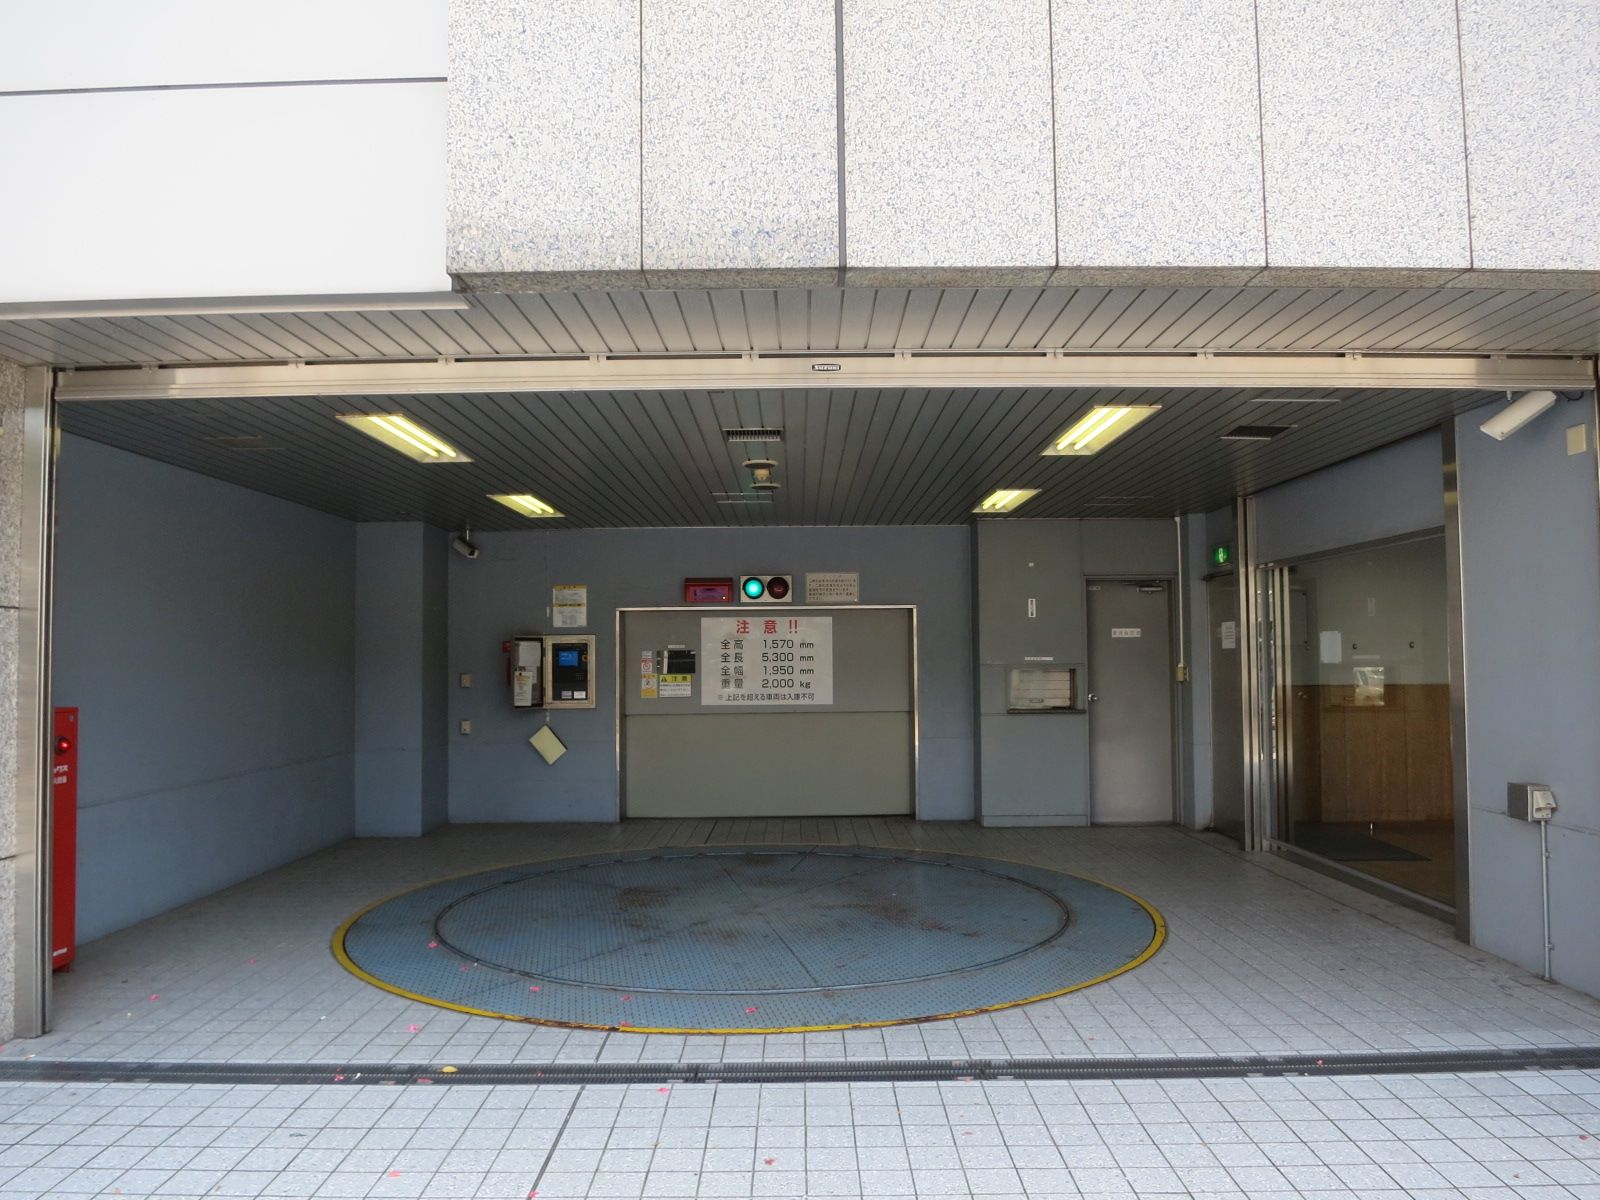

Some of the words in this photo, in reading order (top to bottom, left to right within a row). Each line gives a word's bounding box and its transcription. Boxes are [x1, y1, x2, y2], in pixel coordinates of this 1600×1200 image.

[720, 639, 744, 650] 全高
[762, 639, 794, 650] 1,570
[799, 641, 814, 649] mm
[720, 652, 744, 663] 全長
[761, 652, 794, 663] 5,300
[720, 665, 744, 676] 全幅
[762, 665, 794, 676] 1,950
[720, 678, 744, 689] 重量
[761, 678, 794, 689] 2,000
[799, 681, 811, 689] kg
